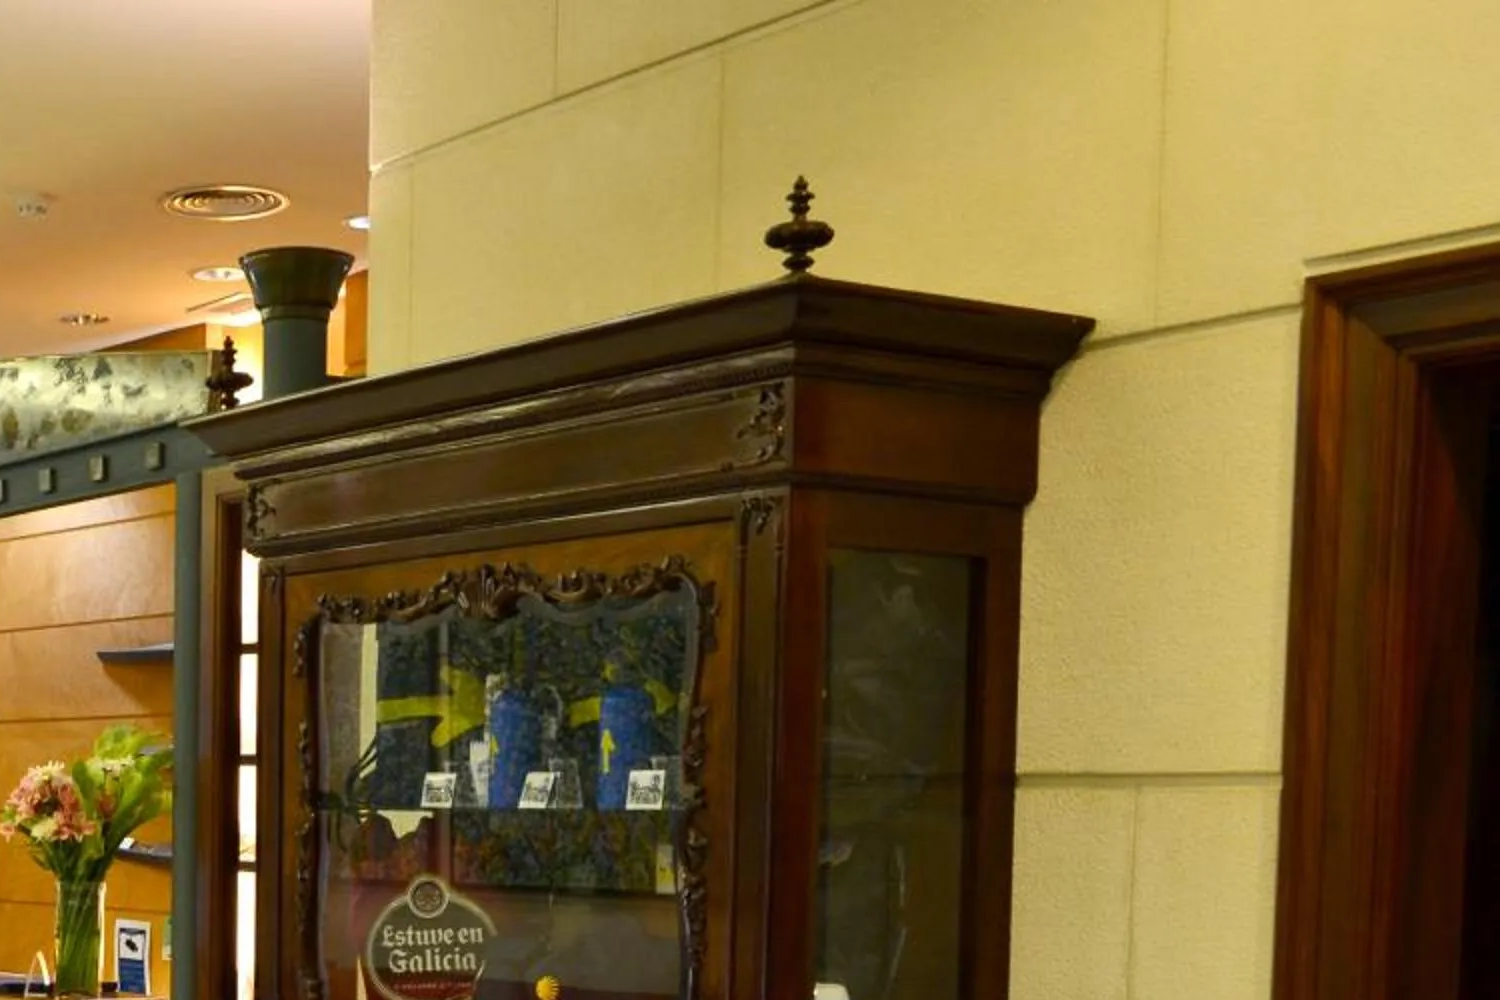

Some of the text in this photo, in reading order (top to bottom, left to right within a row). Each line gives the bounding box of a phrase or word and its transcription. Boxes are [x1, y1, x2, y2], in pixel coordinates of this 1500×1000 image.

[382, 924, 484, 947] Estuve en
[388, 947, 478, 973] Galicia
